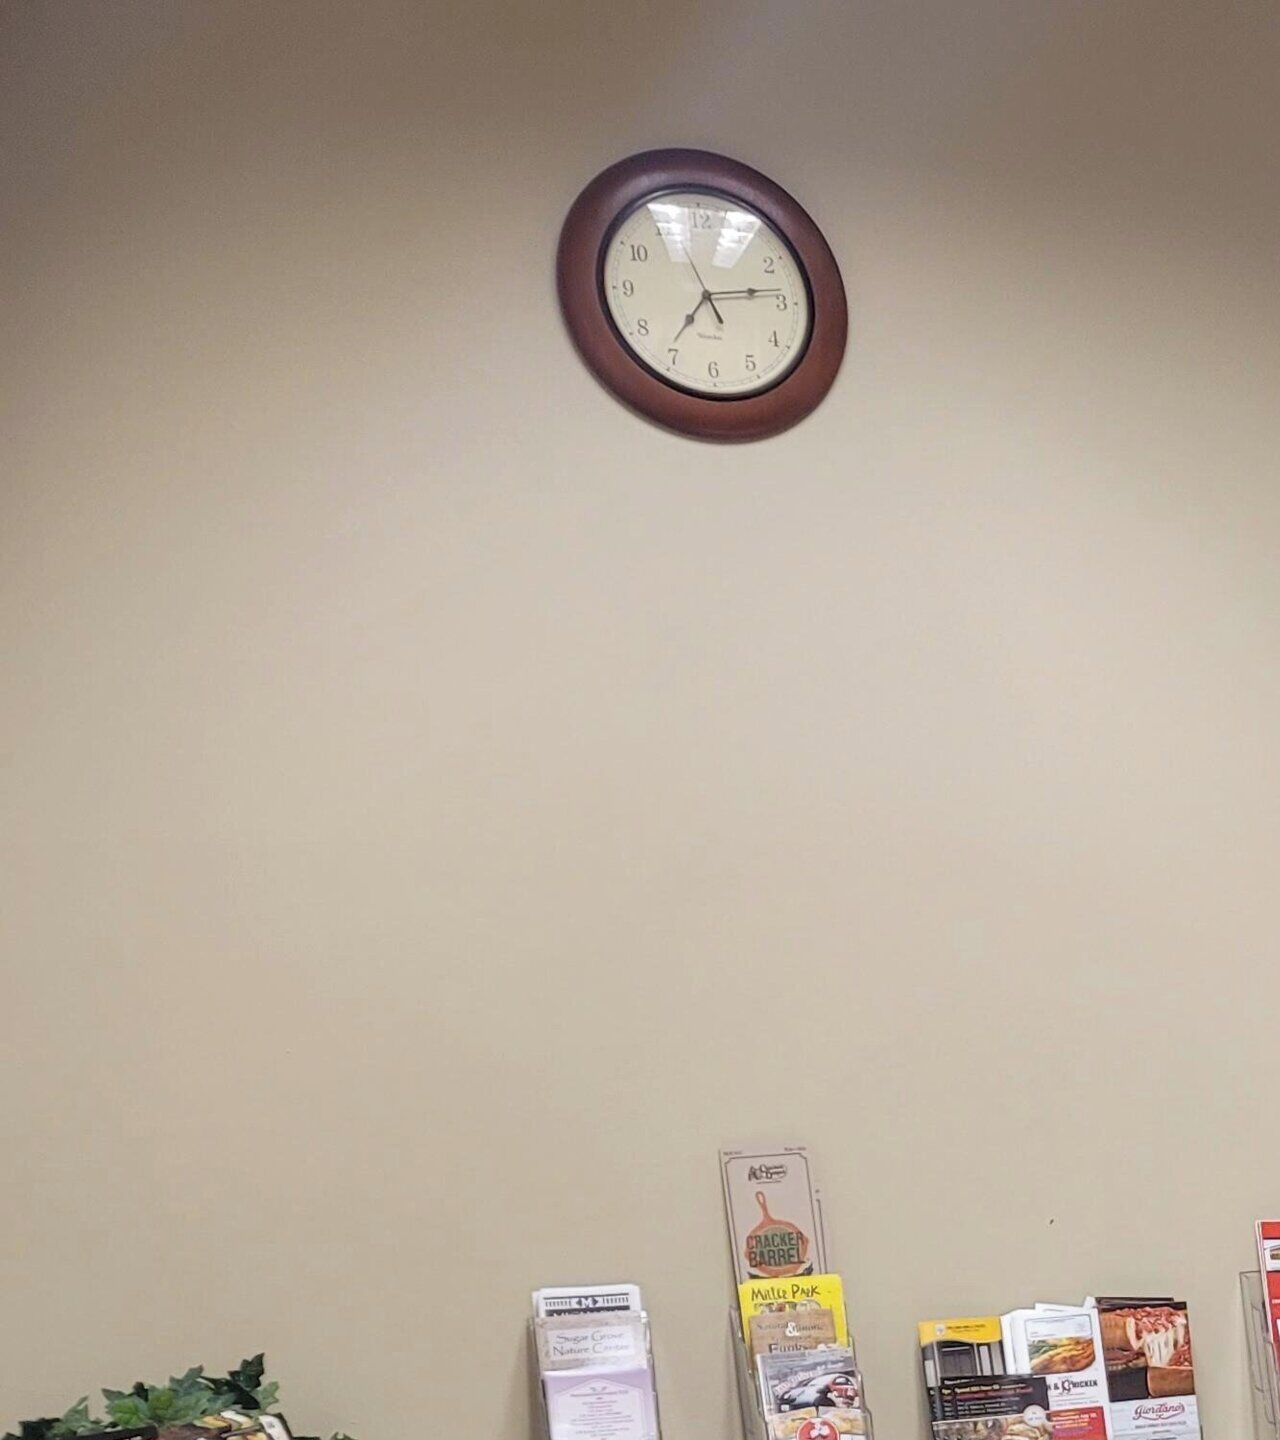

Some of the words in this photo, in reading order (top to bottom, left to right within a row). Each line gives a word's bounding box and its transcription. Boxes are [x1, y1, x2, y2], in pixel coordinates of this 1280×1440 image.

[691, 211, 713, 230] 12
[630, 244, 649, 263] 10
[763, 256, 776, 274] 2
[622, 279, 634, 298] 9
[775, 294, 788, 311] 3
[637, 318, 650, 337] 8
[767, 330, 780, 348] 4
[667, 348, 679, 366] 7
[745, 354, 757, 372] 5
[707, 361, 720, 379] 6
[746, 1231, 805, 1250] CRACKER
[748, 1247, 806, 1268] BARREL
[785, 1321, 800, 1337] &
[553, 1345, 590, 1356] Nature
[1132, 1402, 1186, 1421] Giordano's
